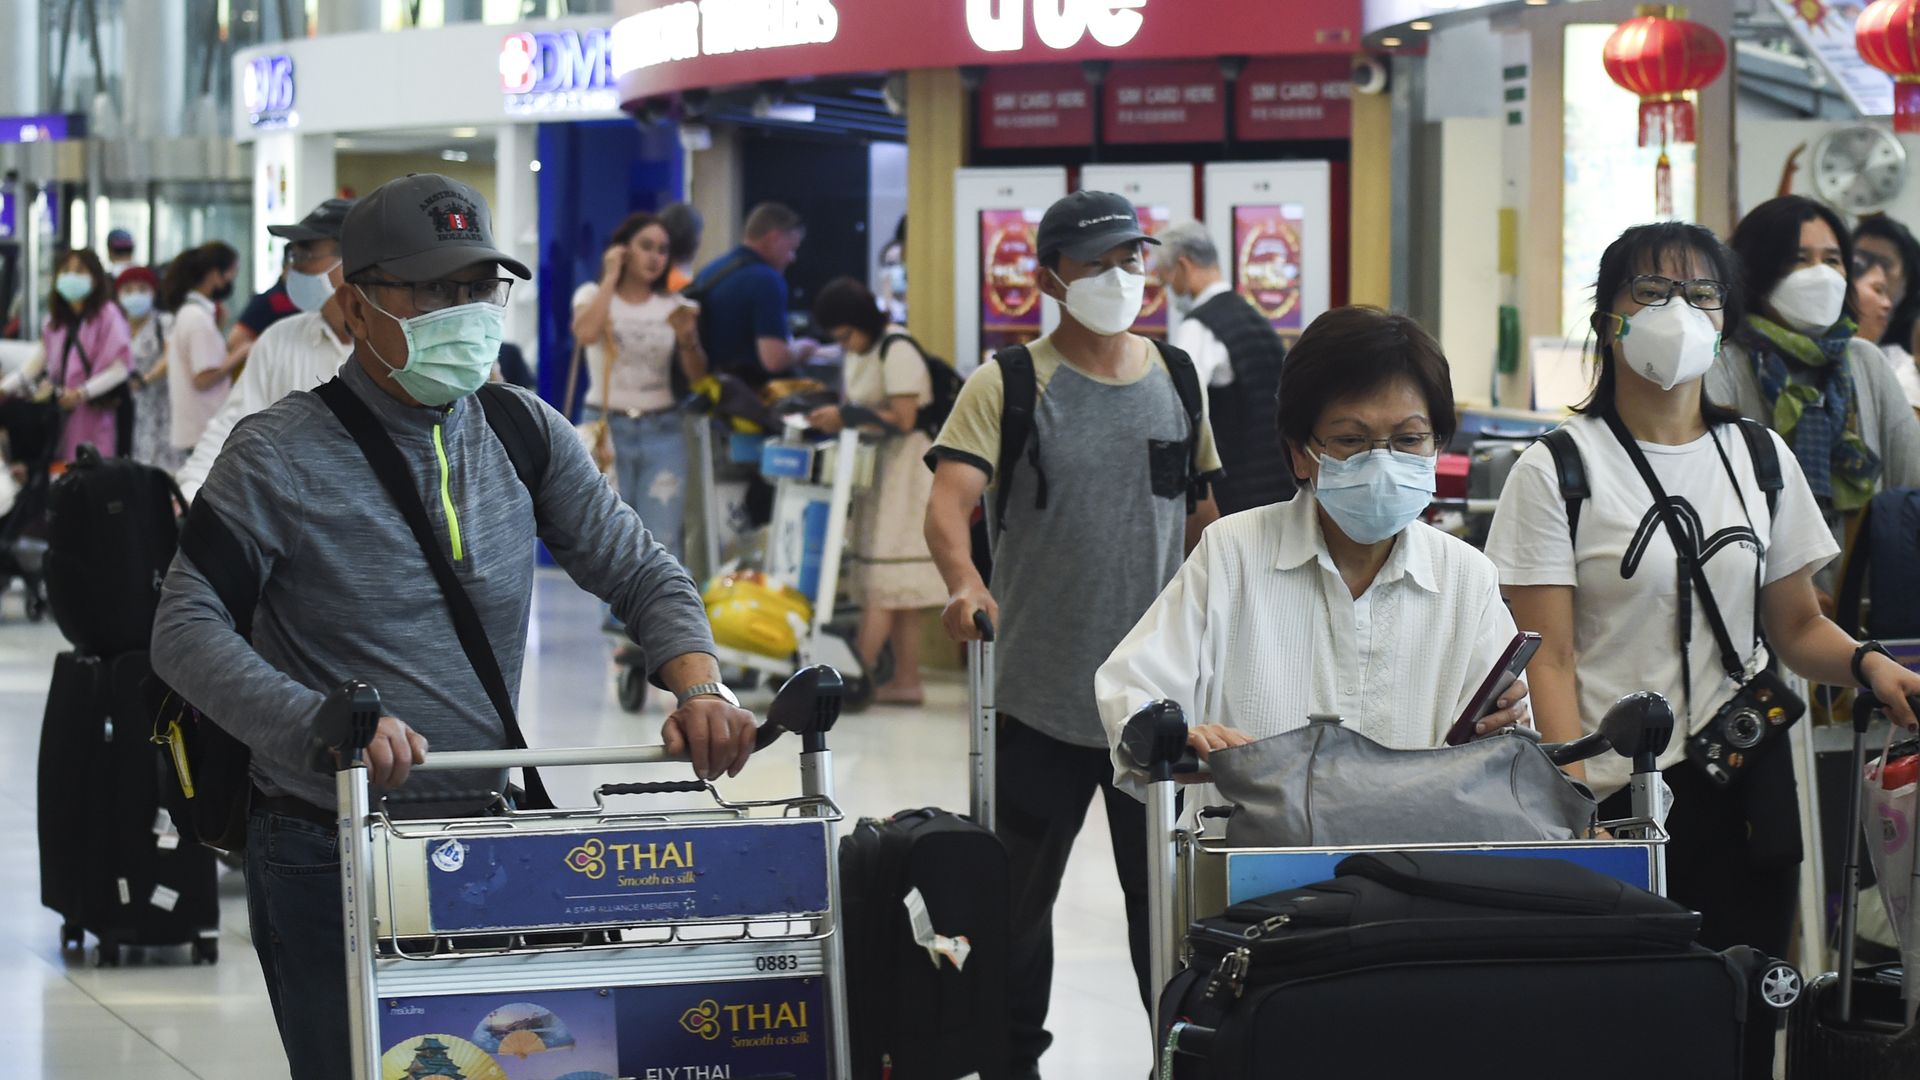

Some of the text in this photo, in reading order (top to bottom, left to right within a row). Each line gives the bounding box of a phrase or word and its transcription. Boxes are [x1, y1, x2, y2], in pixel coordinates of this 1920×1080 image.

[608, 841, 694, 871] THAI
[617, 872, 696, 887] Smooth as silk
[565, 906, 573, 914] A
[573, 905, 596, 913] STAR
[641, 901, 679, 911] MEMBER
[755, 955, 798, 971] 0883
[723, 1001, 808, 1032] THAI
[731, 1032, 809, 1048] Smooth as silk
[682, 1064, 730, 1080] THAI
